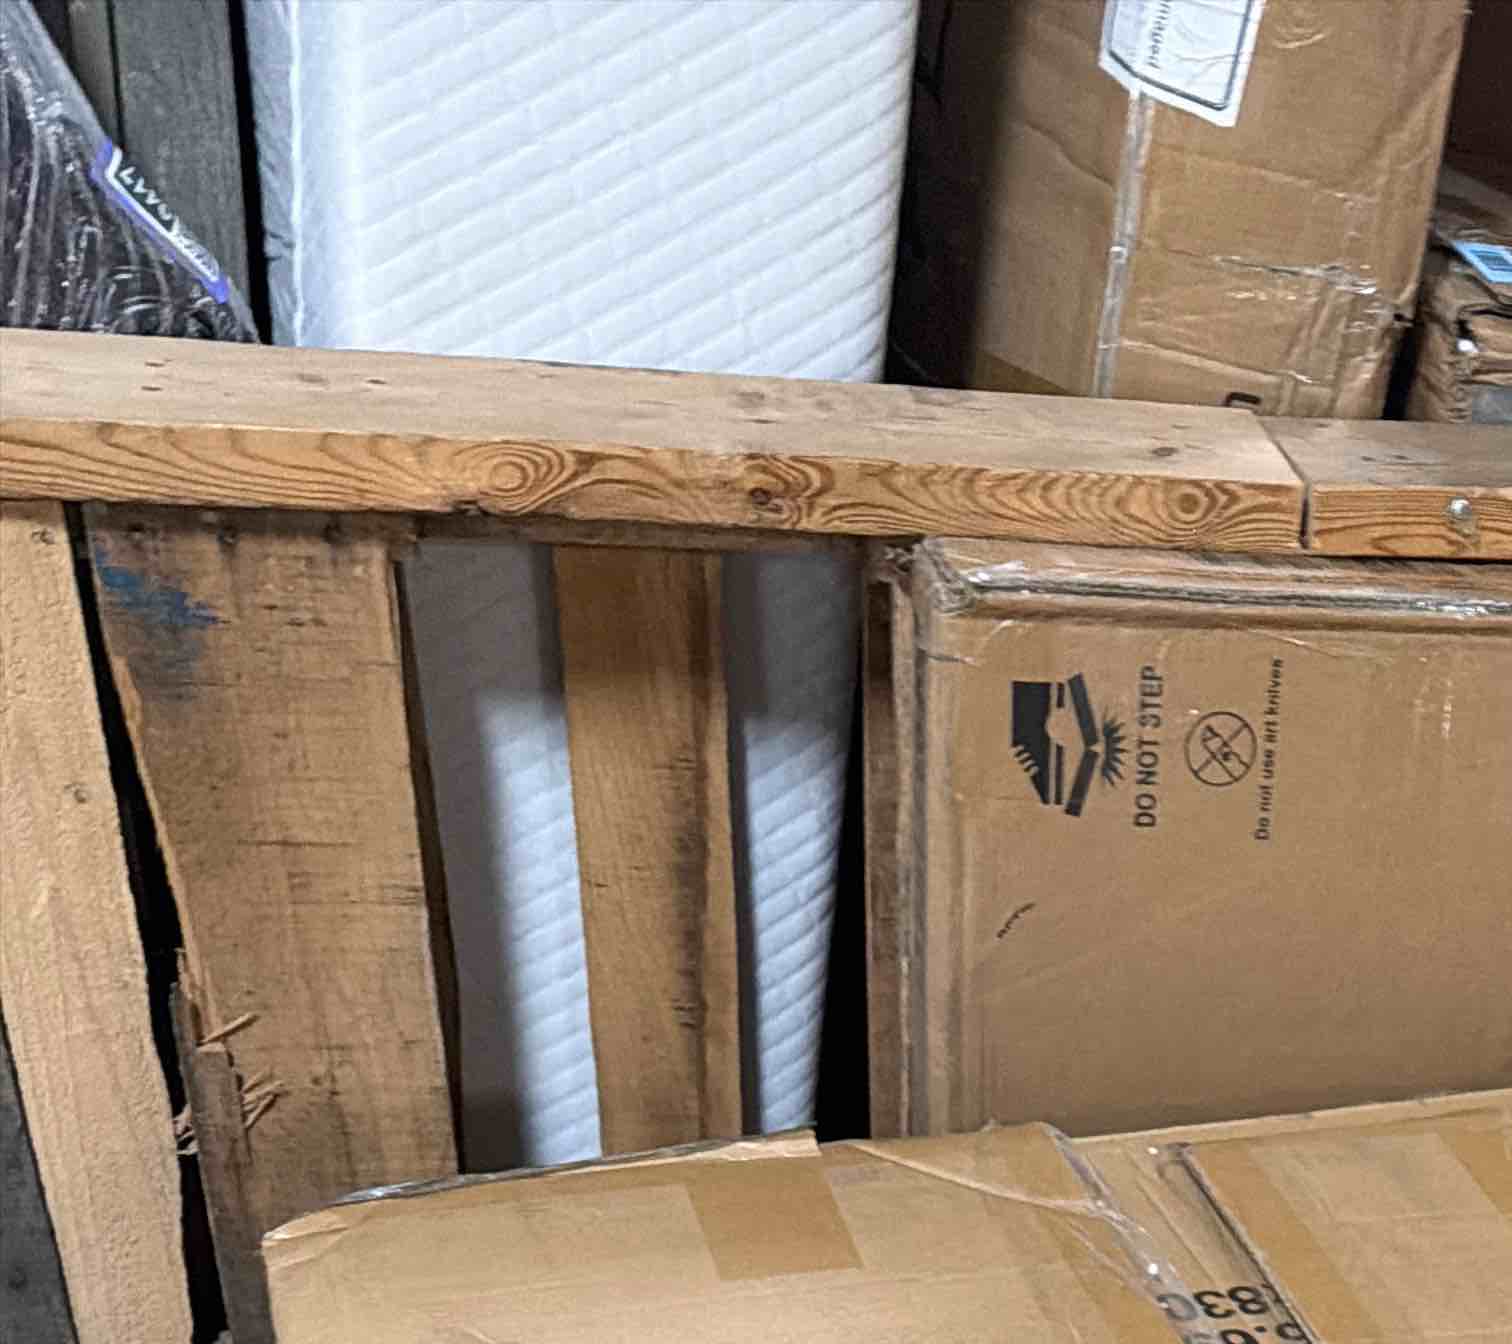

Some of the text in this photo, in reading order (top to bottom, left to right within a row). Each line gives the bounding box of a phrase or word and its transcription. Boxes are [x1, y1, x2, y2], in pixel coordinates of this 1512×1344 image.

[1134, 665, 1165, 828] DO NOT STEP
[1261, 749, 1277, 780] use
